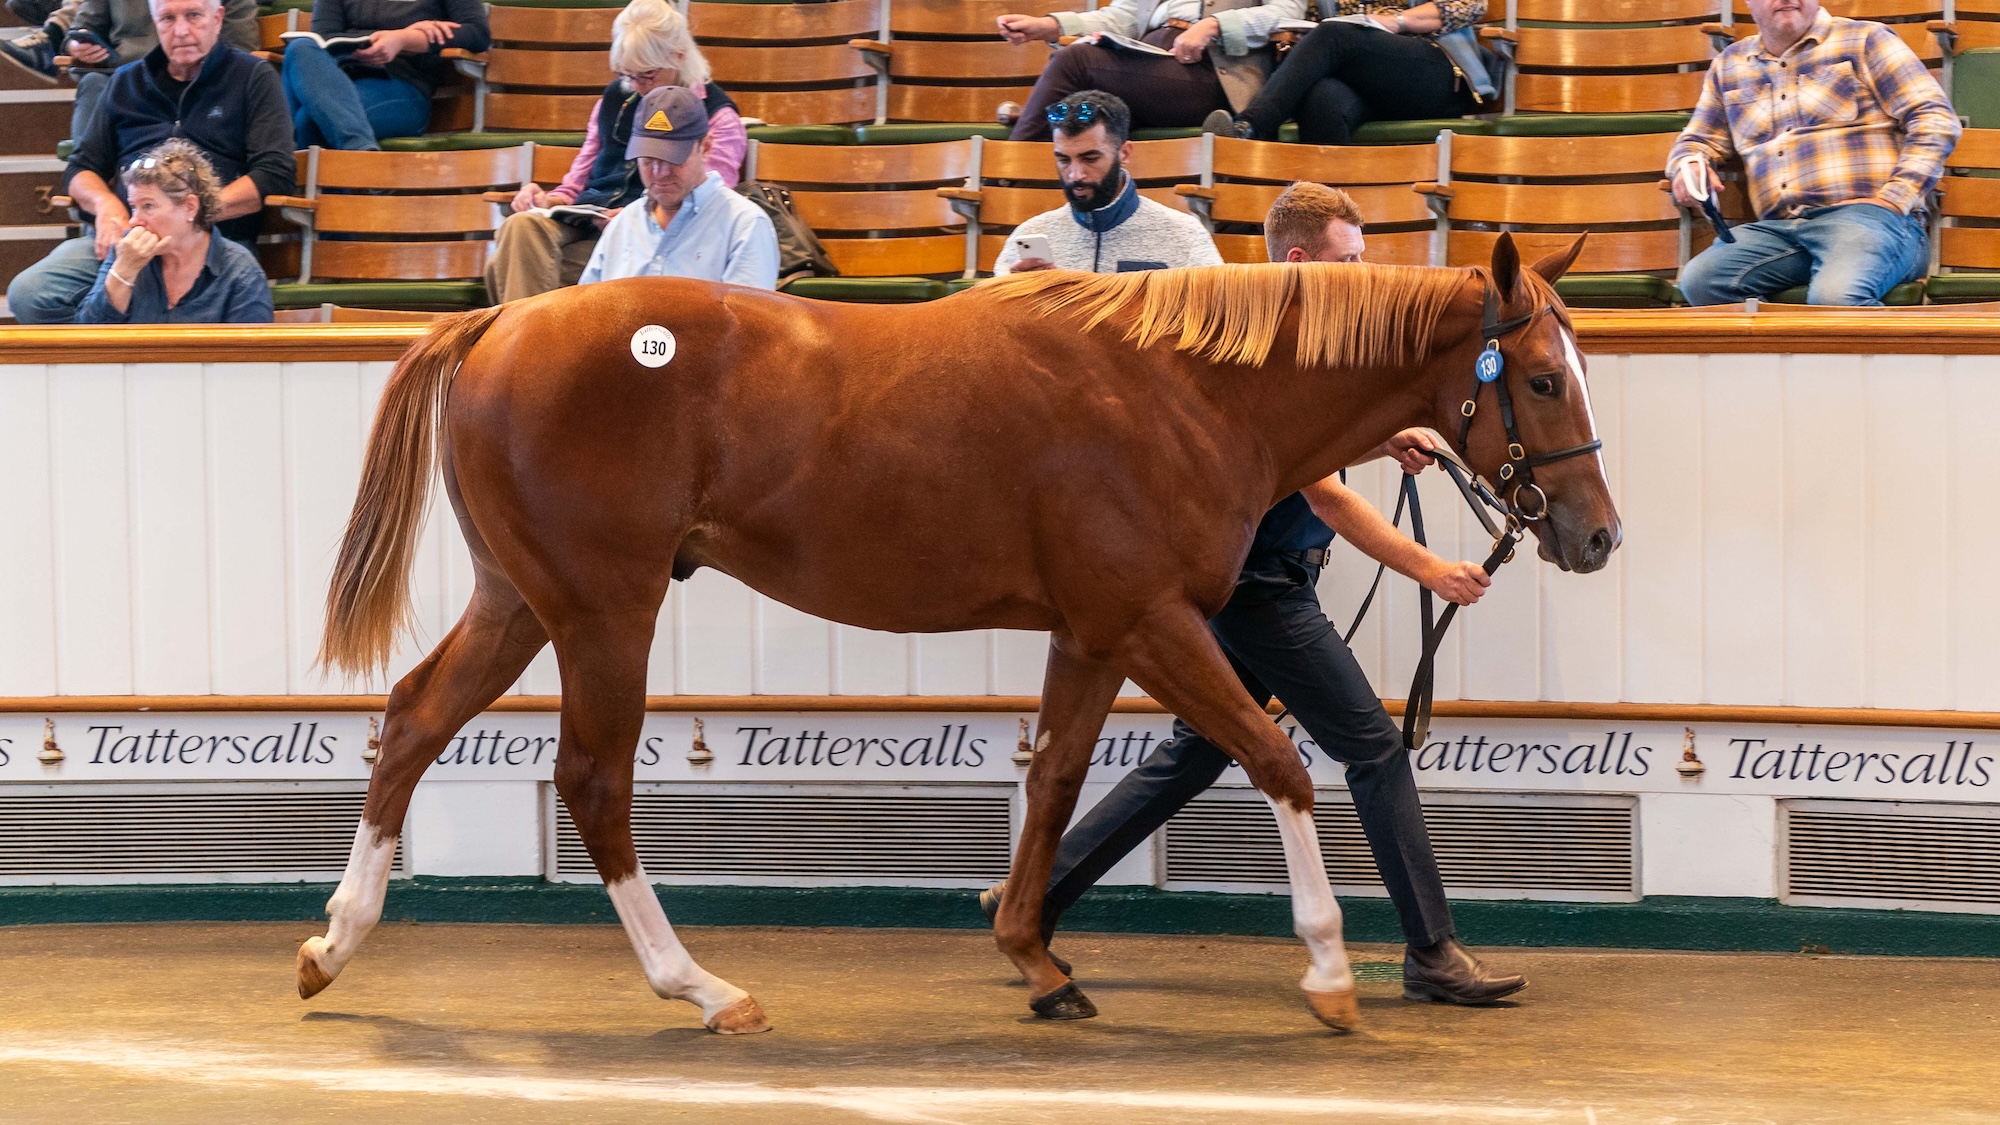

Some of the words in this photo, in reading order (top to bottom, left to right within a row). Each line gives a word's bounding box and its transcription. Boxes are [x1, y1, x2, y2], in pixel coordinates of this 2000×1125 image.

[641, 340, 666, 356] 130
[1481, 356, 1497, 378] 130
[87, 722, 338, 764] Tattersalls
[735, 724, 989, 767] Tattersalls
[1401, 731, 1653, 776] attersalls
[1728, 738, 1994, 787] Tattersalls
